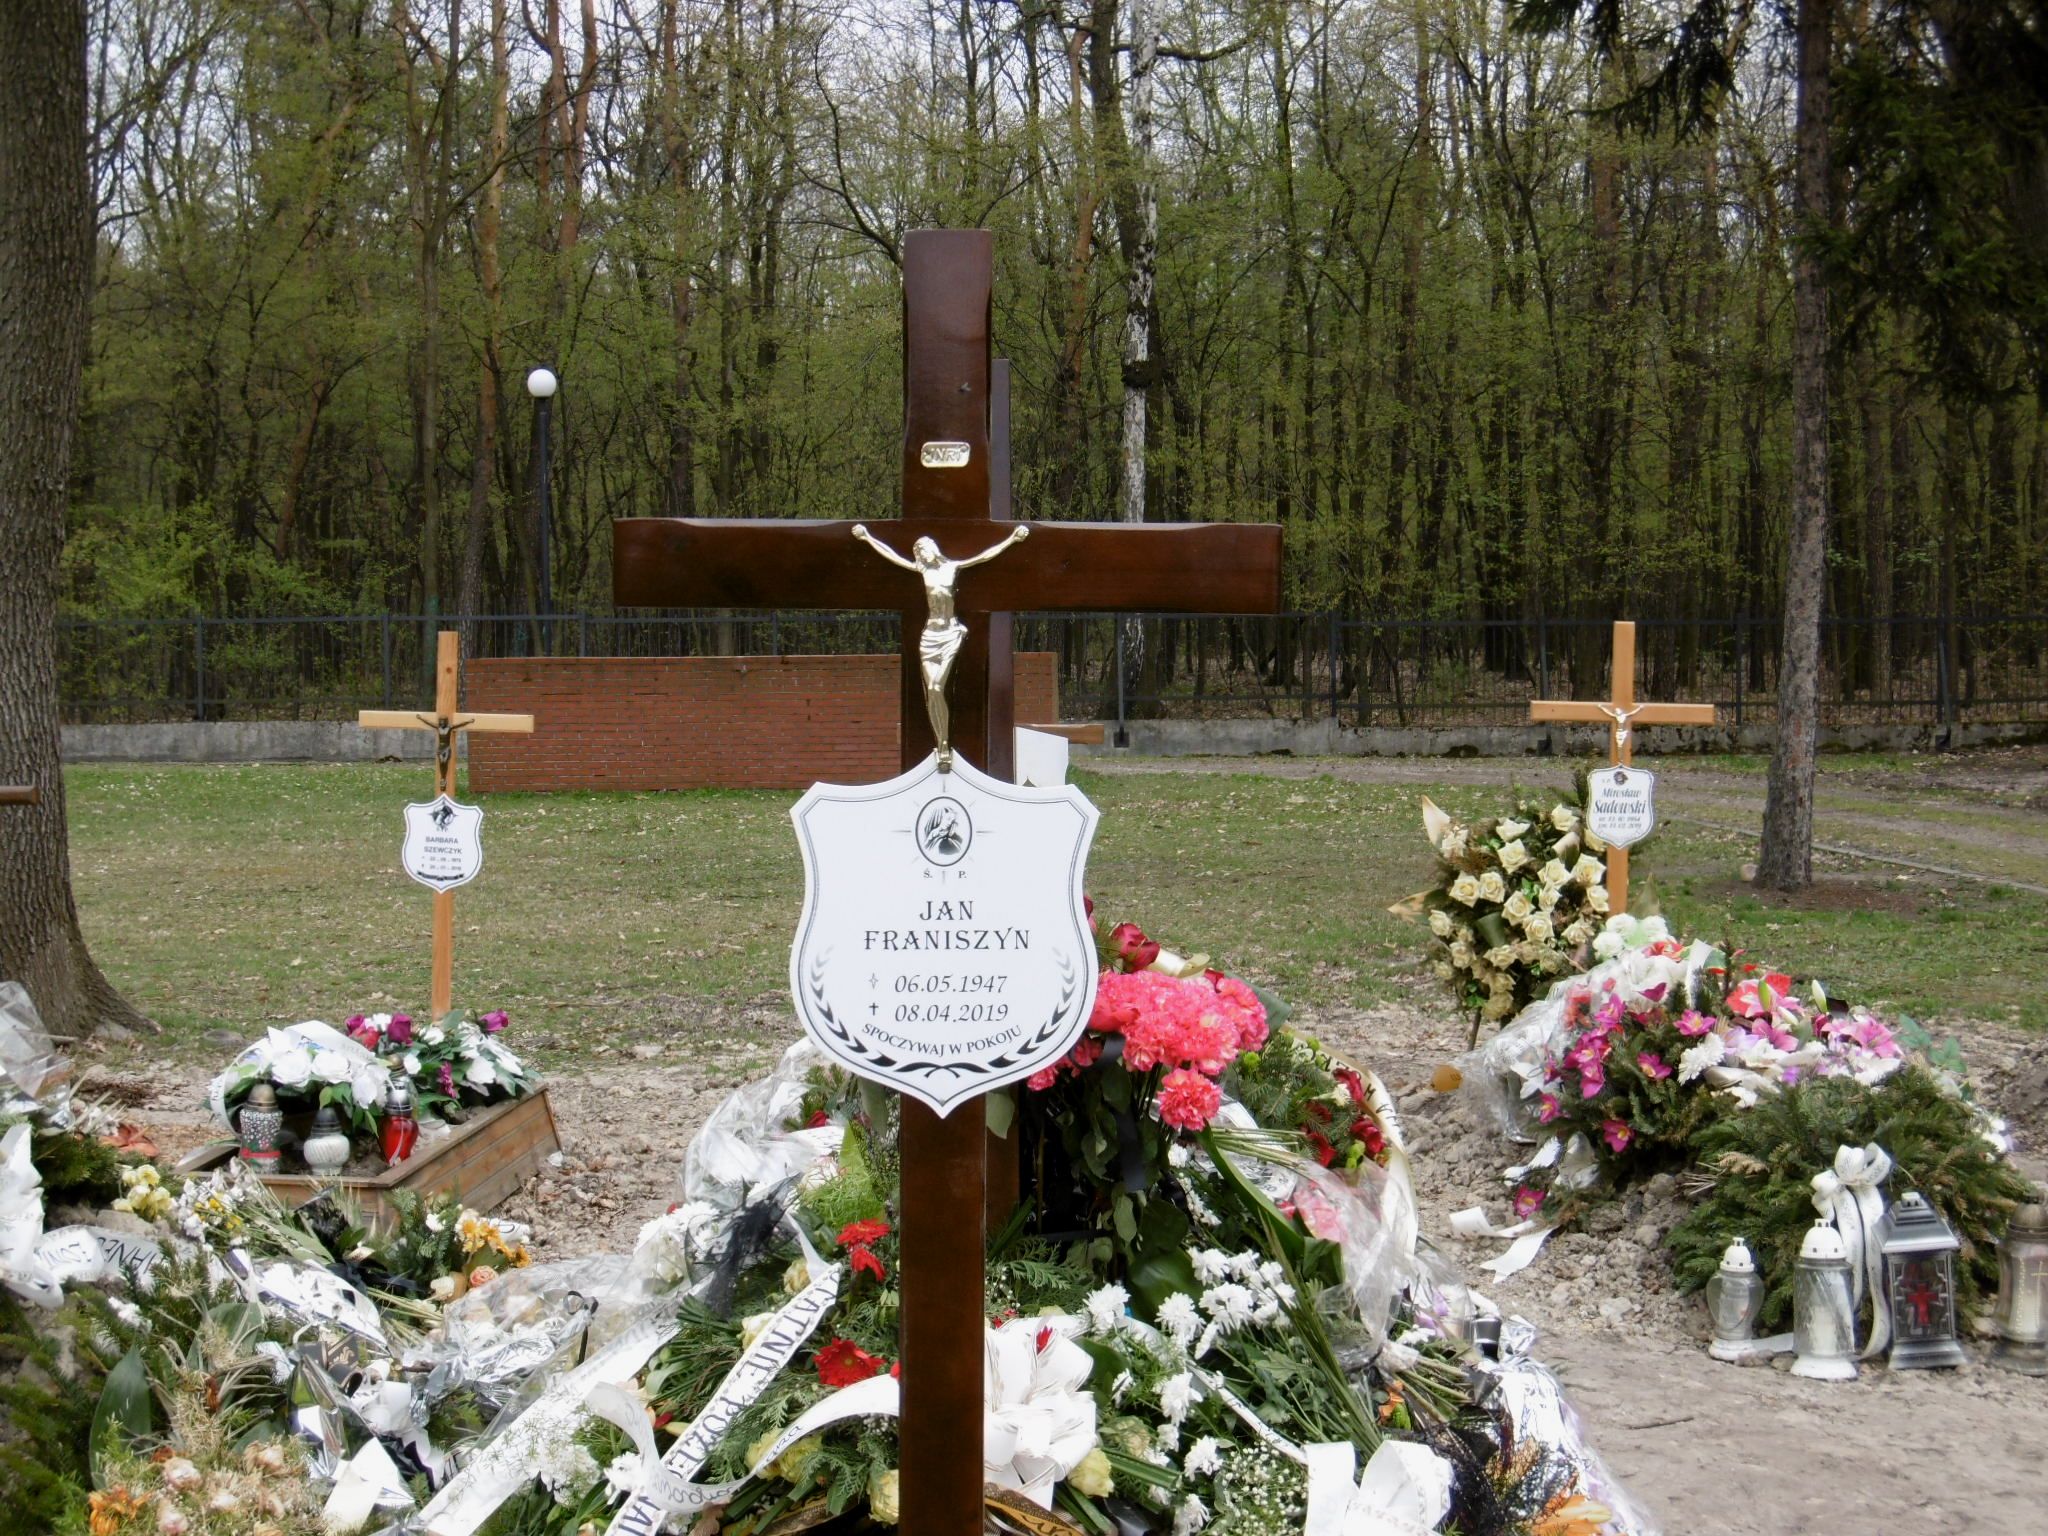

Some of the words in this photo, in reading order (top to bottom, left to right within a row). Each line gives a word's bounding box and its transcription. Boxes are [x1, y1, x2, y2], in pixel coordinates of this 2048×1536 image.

[425, 836, 458, 844] BARBARA
[424, 846, 462, 854] SZEWCZYK
[958, 870, 967, 879] P.
[919, 900, 974, 921] JAN
[864, 927, 1030, 951] FRANISZYN
[894, 975, 1008, 994] 06.05.1947
[894, 1003, 1009, 1023] 08.04.2019
[862, 1023, 945, 1057] SPOCZYWAJ
[950, 1043, 962, 1055] W
[967, 1024, 1022, 1053] POKOJU
